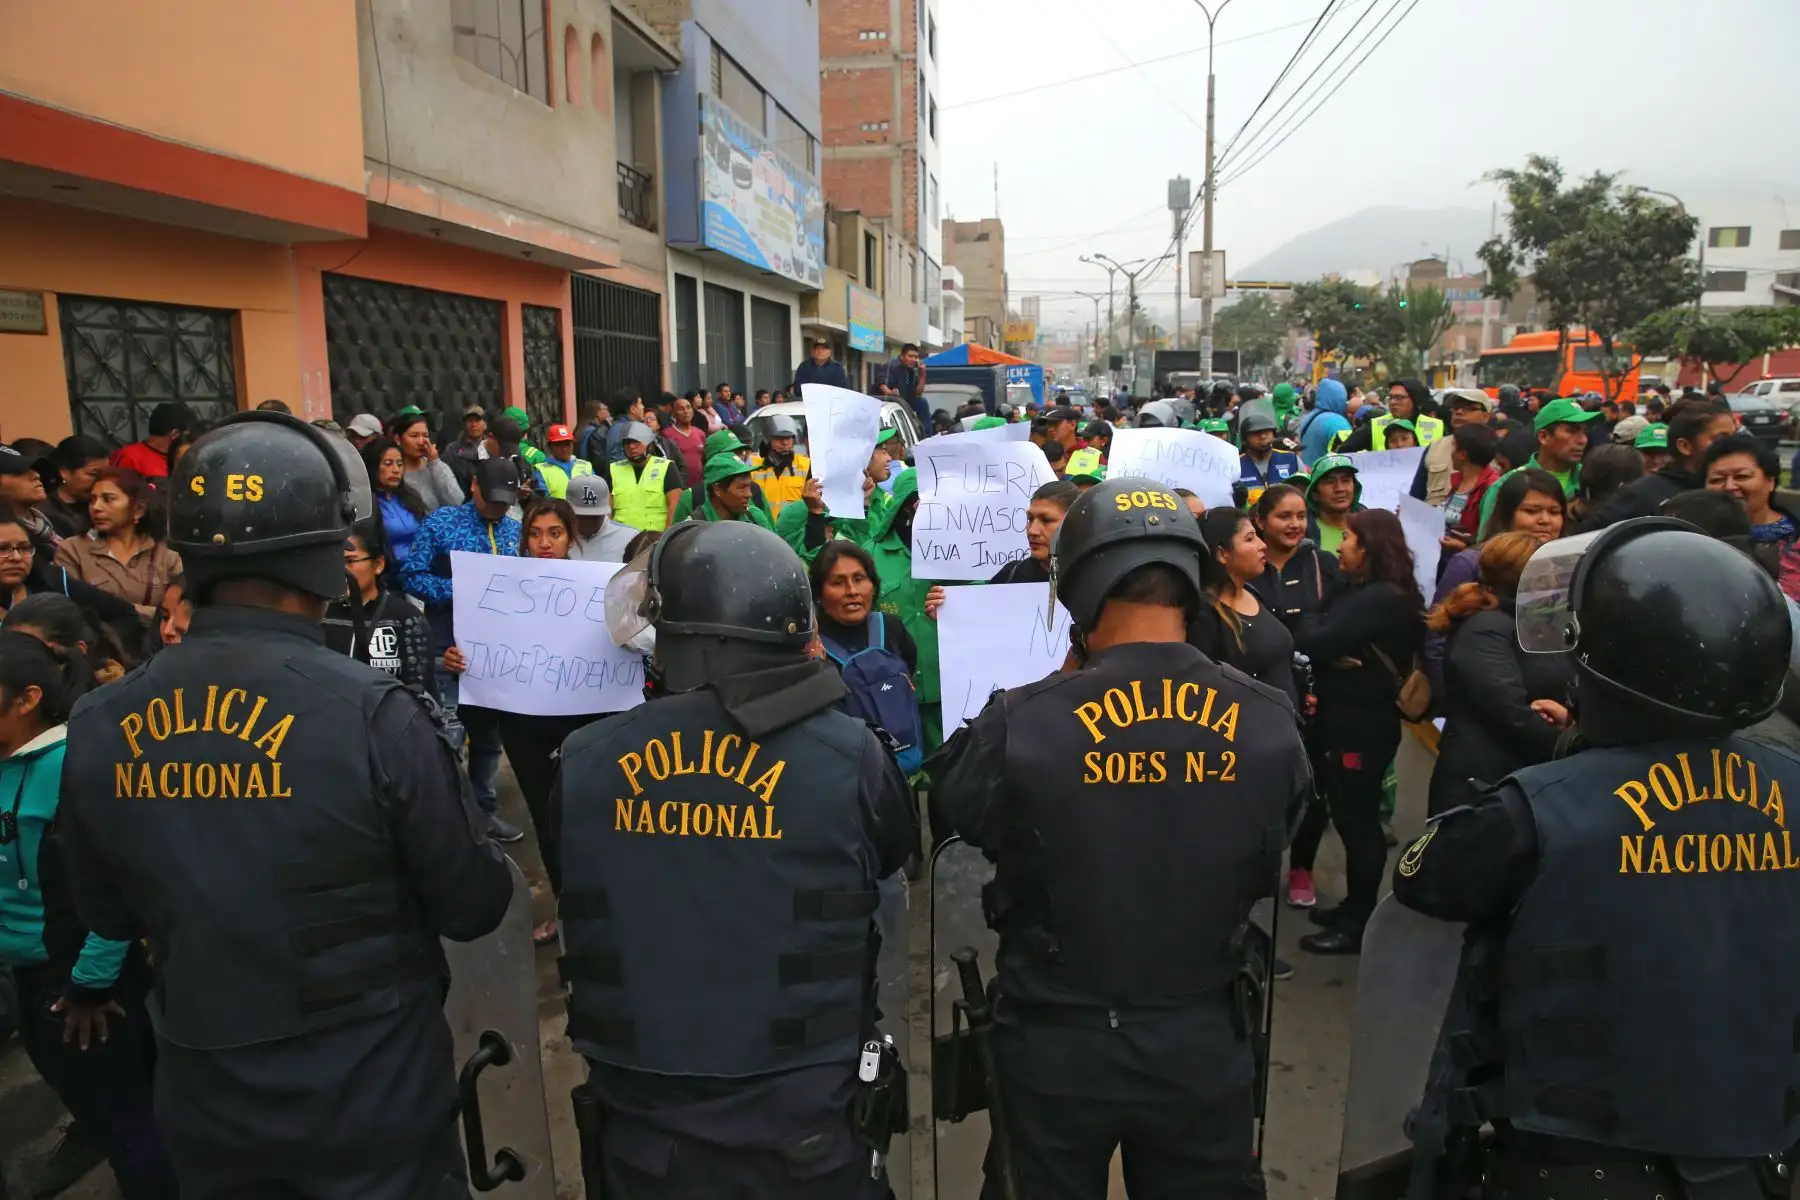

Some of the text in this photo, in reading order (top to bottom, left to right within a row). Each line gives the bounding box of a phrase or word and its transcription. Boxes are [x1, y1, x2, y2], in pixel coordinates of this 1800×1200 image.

[582, 486, 597, 505] LA
[926, 454, 1041, 499] FUERA
[917, 502, 1027, 533] INVASO
[1115, 490, 1178, 513] SOES
[916, 539, 960, 561] VIVA
[477, 573, 577, 617] ESTO
[121, 684, 294, 761] POLICIA
[1075, 678, 1241, 745] POLICIA
[114, 761, 293, 800] NACIONAL
[617, 729, 786, 804] POLICIA
[1083, 751, 1237, 784] SOES N-2
[1614, 749, 1785, 832] POLICIA
[614, 799, 783, 840] NACIONAL
[1618, 830, 1800, 874] NACIONAL
